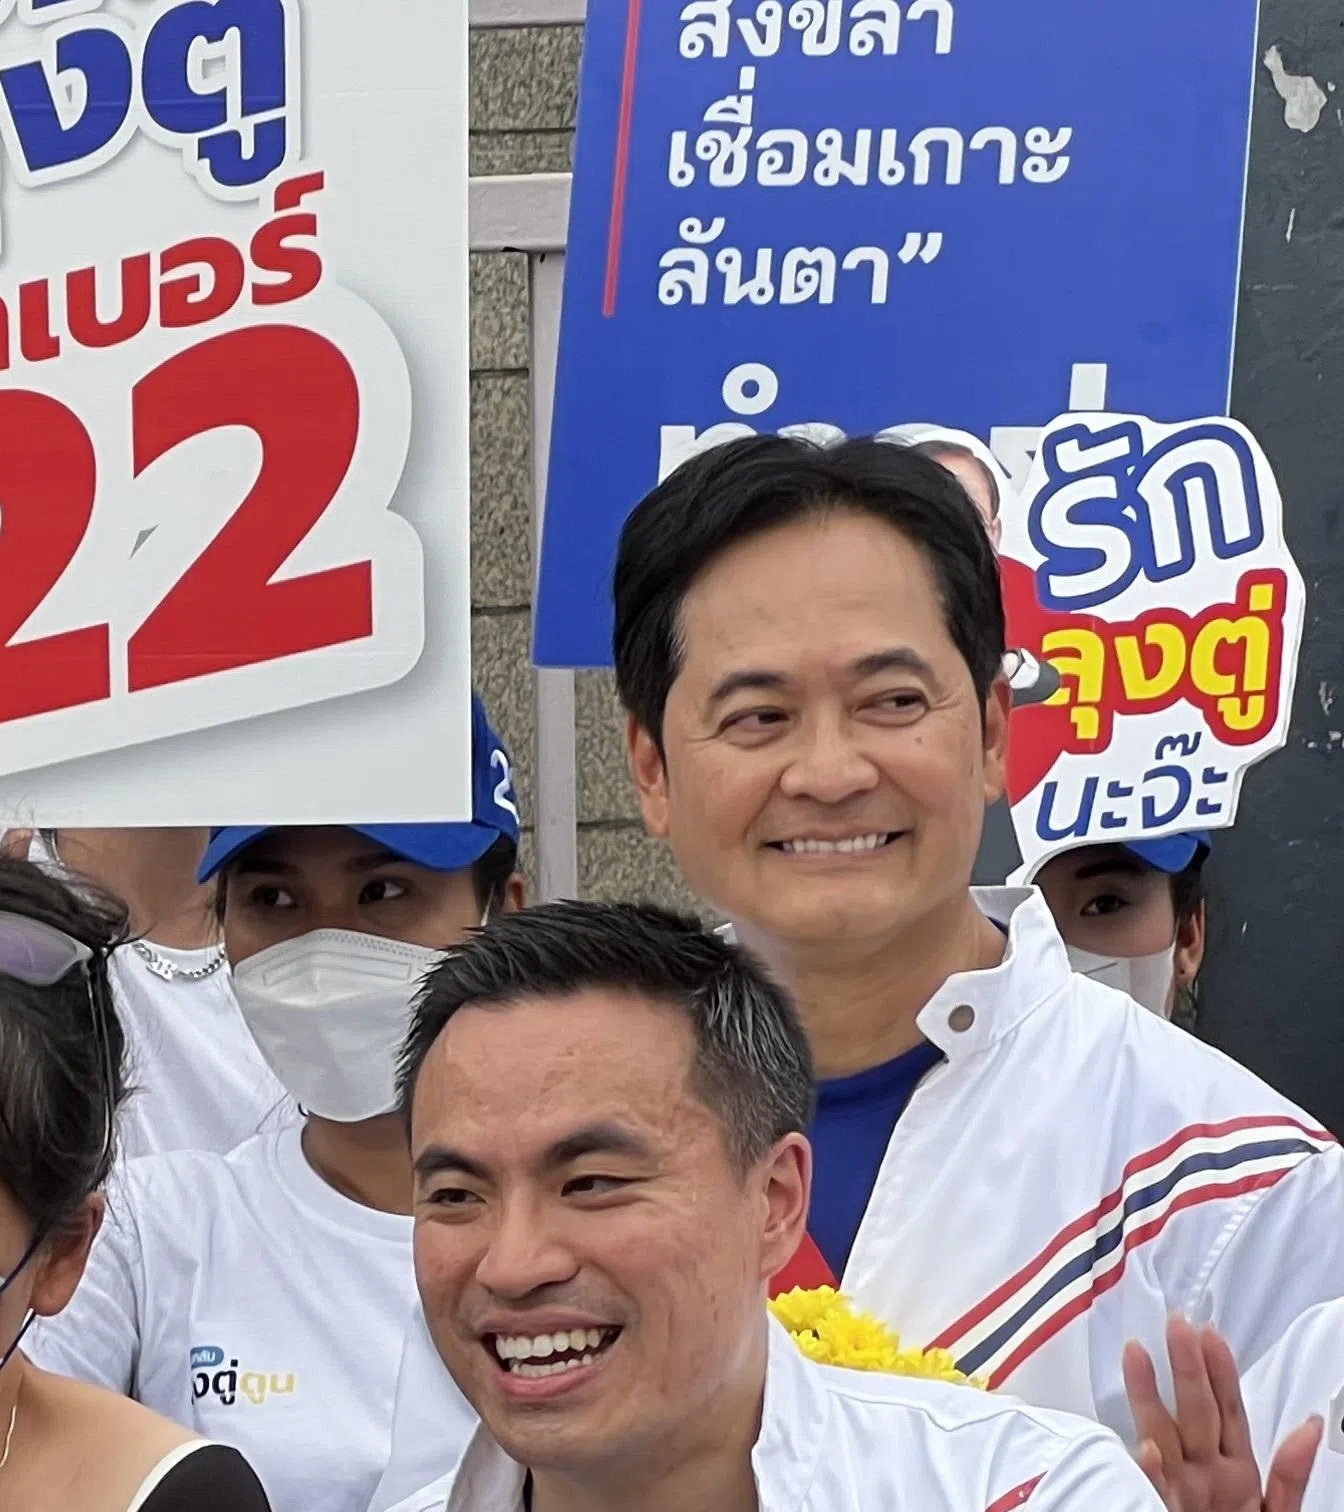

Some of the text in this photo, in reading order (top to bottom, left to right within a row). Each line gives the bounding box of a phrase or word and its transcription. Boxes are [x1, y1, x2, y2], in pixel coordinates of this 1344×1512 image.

[667, 65, 1073, 188] เชื่อมเกาะ
[658, 216, 943, 306] ลันตา”
[1030, 423, 1262, 609] รัก
[1041, 583, 1275, 740] ลุงตู่
